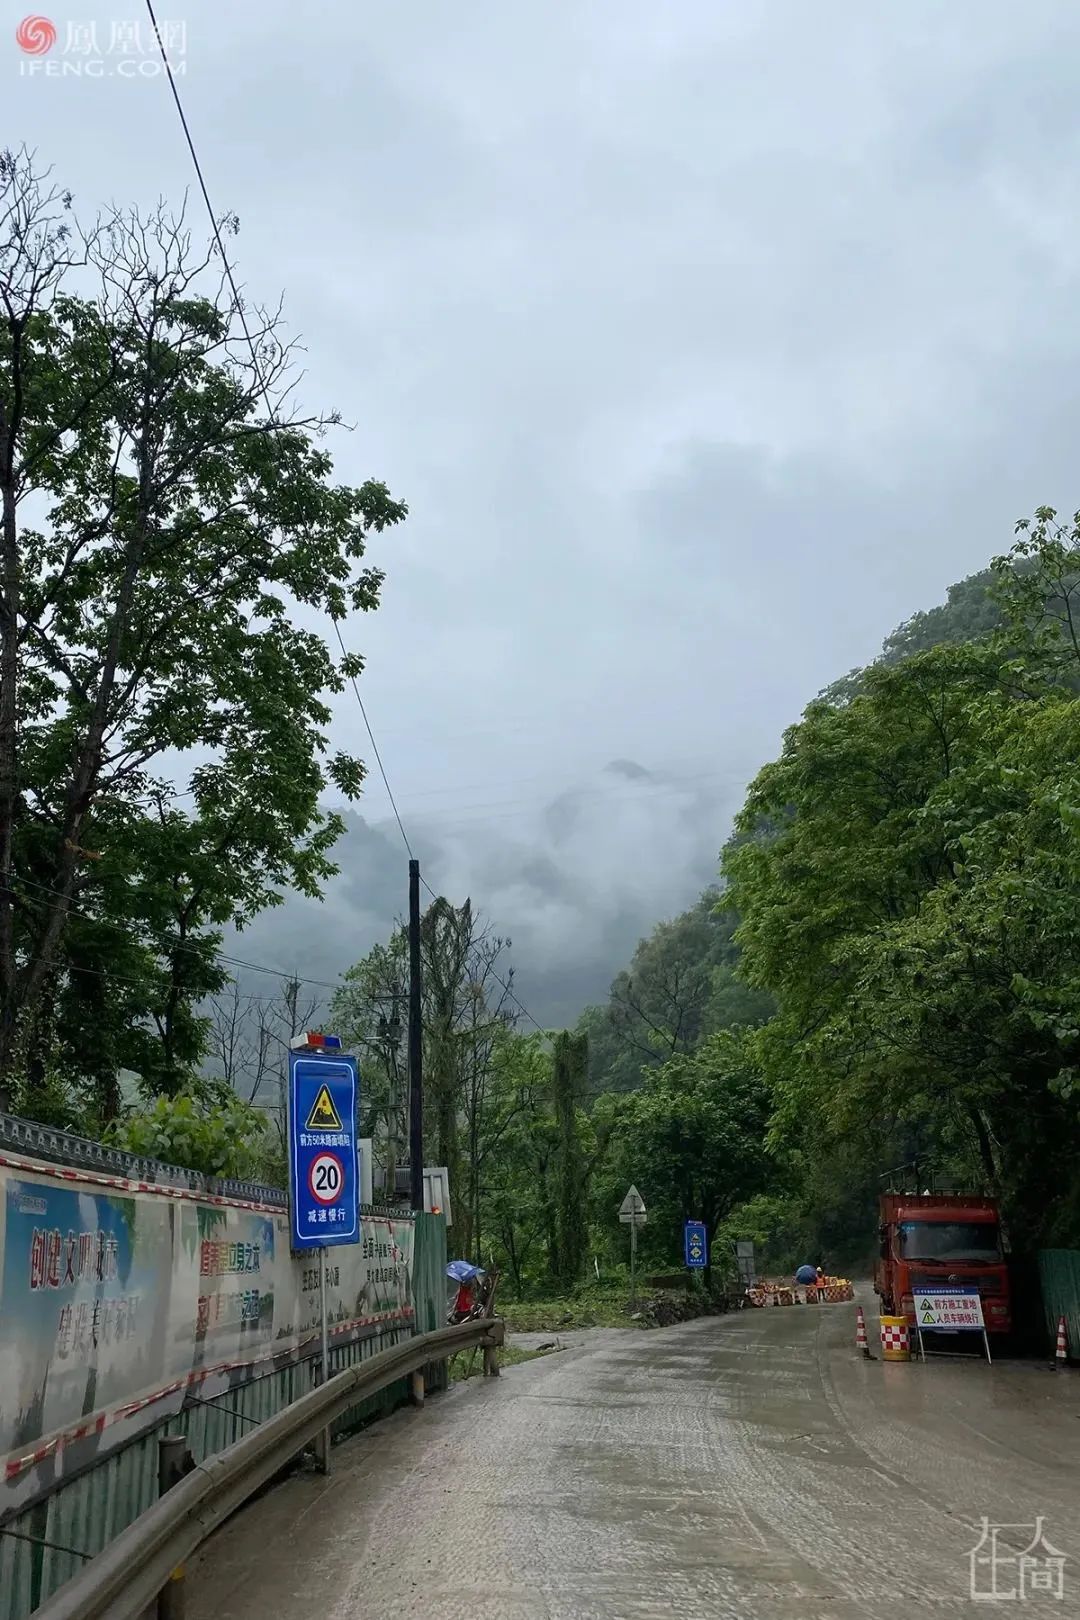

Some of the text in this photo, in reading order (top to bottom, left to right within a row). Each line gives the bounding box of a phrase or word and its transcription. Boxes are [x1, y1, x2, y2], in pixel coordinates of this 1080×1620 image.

[316, 1165, 339, 1191] 20
[307, 1208, 346, 1223] 减速慢行
